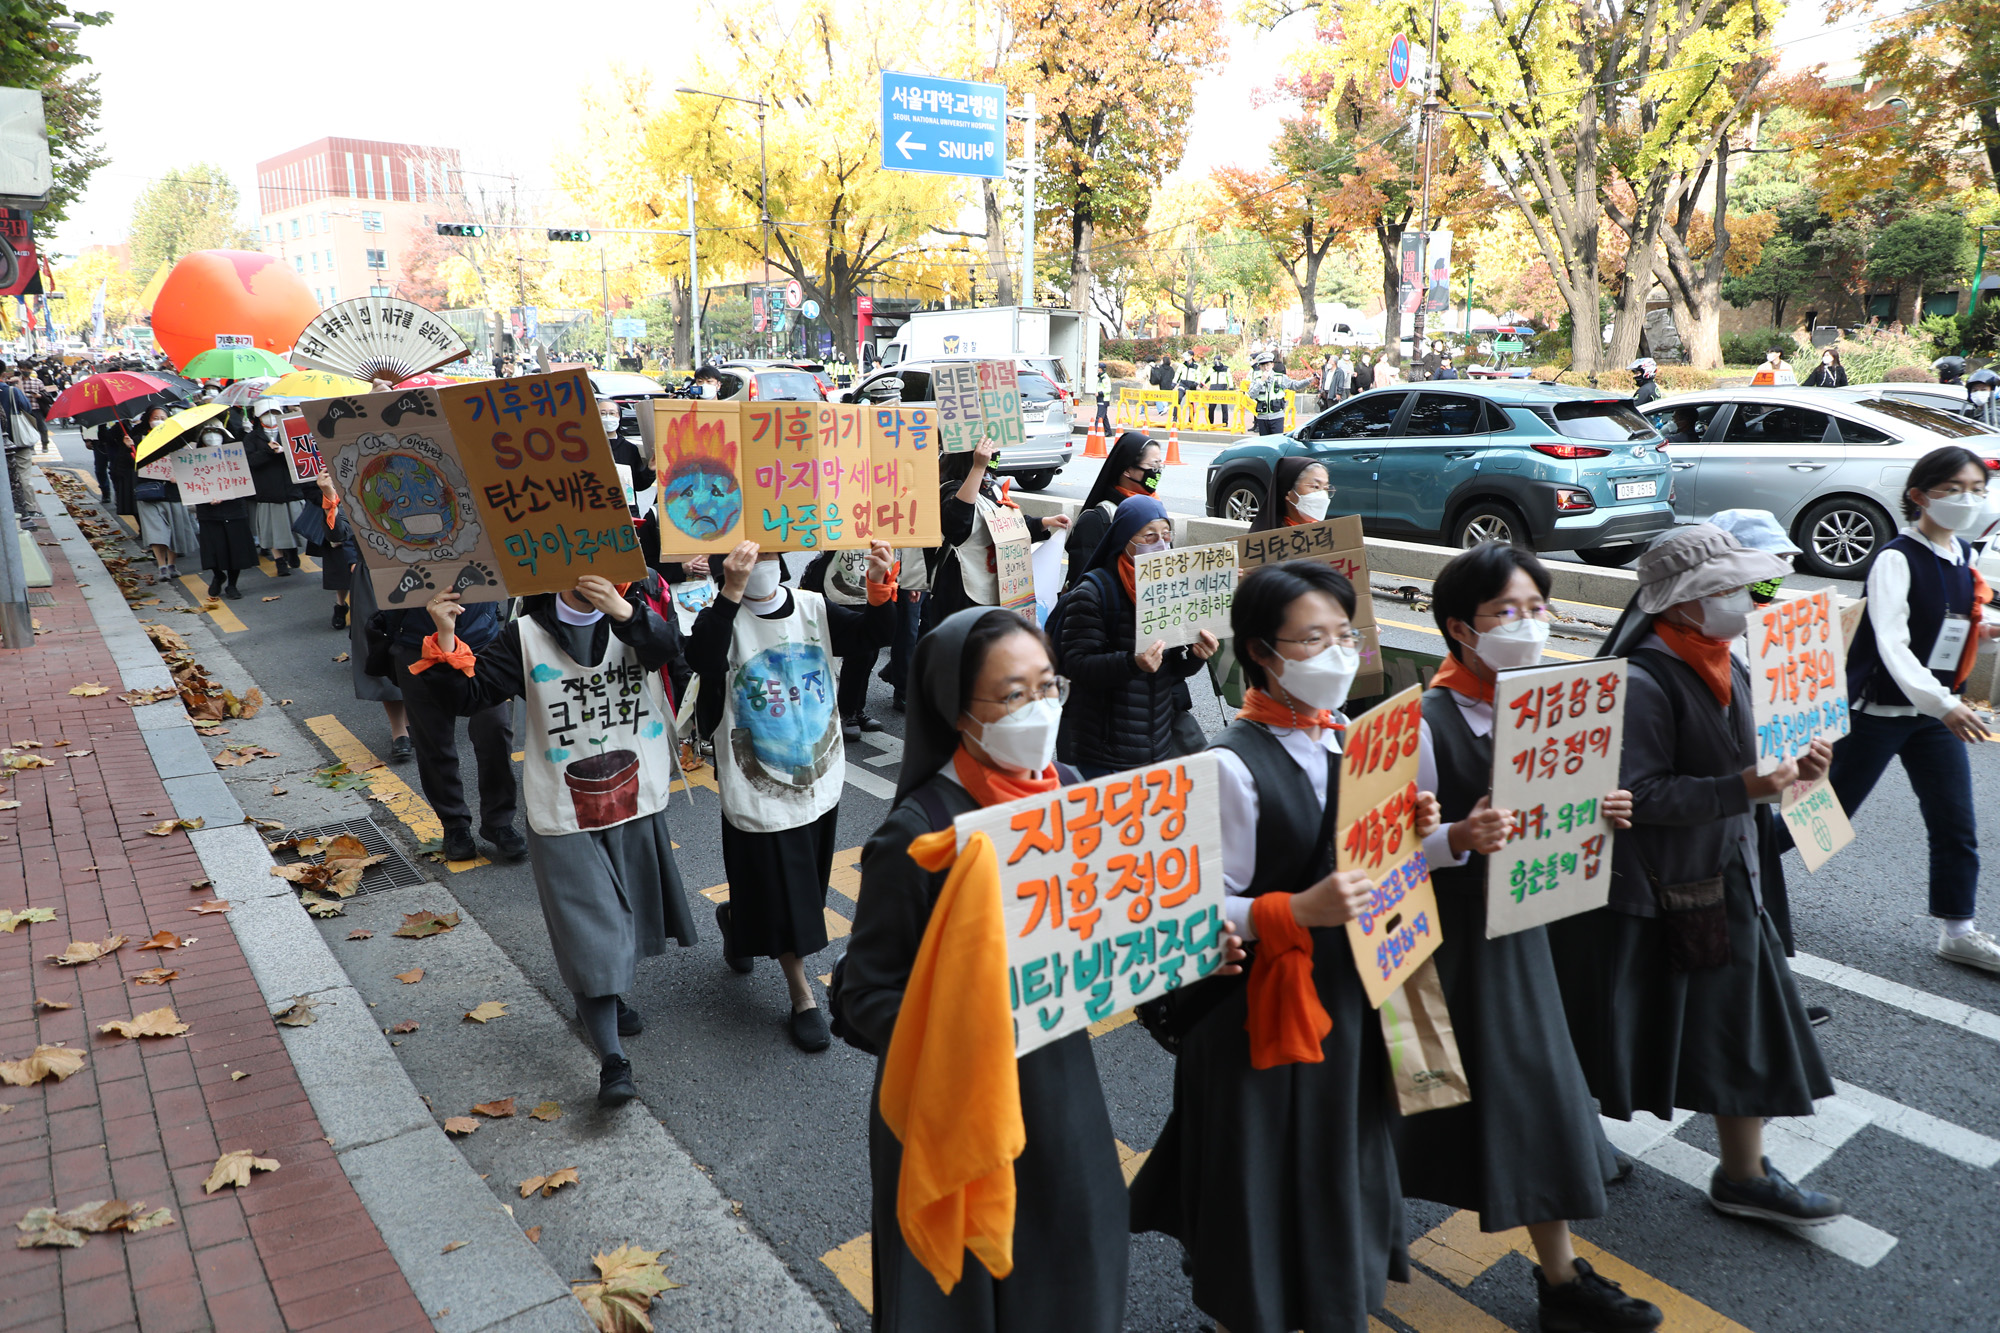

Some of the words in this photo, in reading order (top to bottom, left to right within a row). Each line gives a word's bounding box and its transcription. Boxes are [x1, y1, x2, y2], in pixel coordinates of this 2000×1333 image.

[891, 86, 998, 120] 서울대학교병원
[893, 113, 911, 122] SEOUL
[912, 115, 940, 126] NATIONAL
[940, 119, 971, 129] UNIVERSITY
[971, 121, 996, 131] HOSPITAL
[938, 140, 984, 161] SNUH
[217, 336, 252, 346] 기후위기
[303, 336, 328, 359] 우리
[321, 312, 354, 338] 공동의
[359, 305, 371, 325] 집
[381, 307, 414, 329] 지구를
[418, 320, 452, 351] 살리자
[464, 374, 587, 425] 기후위기
[935, 361, 1017, 395] 석탄화력
[938, 390, 1020, 420] 중단만이
[491, 420, 590, 471] SOS
[750, 406, 863, 451] 기후위기
[877, 408, 932, 451] 막을
[484, 470, 628, 523] 탄소배출을
[755, 455, 845, 501] 마지막
[848, 456, 909, 500] 세대,
[762, 502, 844, 549] 나중은
[852, 499, 918, 540] 없다!
[1245, 525, 1336, 563] 석탄화력
[503, 523, 640, 577] 막아주세요
[838, 552, 866, 571] 생명
[1191, 543, 1235, 574] 기후정의
[1194, 570, 1232, 593] 에너지
[1141, 604, 1183, 635] 공공성
[1760, 592, 1830, 660] 지금당장
[746, 674, 801, 718] 공동의
[1765, 649, 1836, 705] 기후정의
[1510, 671, 1620, 734] 지금당장
[1512, 725, 1612, 784] 기후정의
[1006, 764, 1194, 867] 지금당장
[1557, 798, 1598, 834] 우리
[1509, 851, 1578, 904] 후손들의
[1580, 833, 1606, 881] 집
[1016, 843, 1202, 941] 기후정의
[1008, 903, 1227, 1050] 탄발전중단
